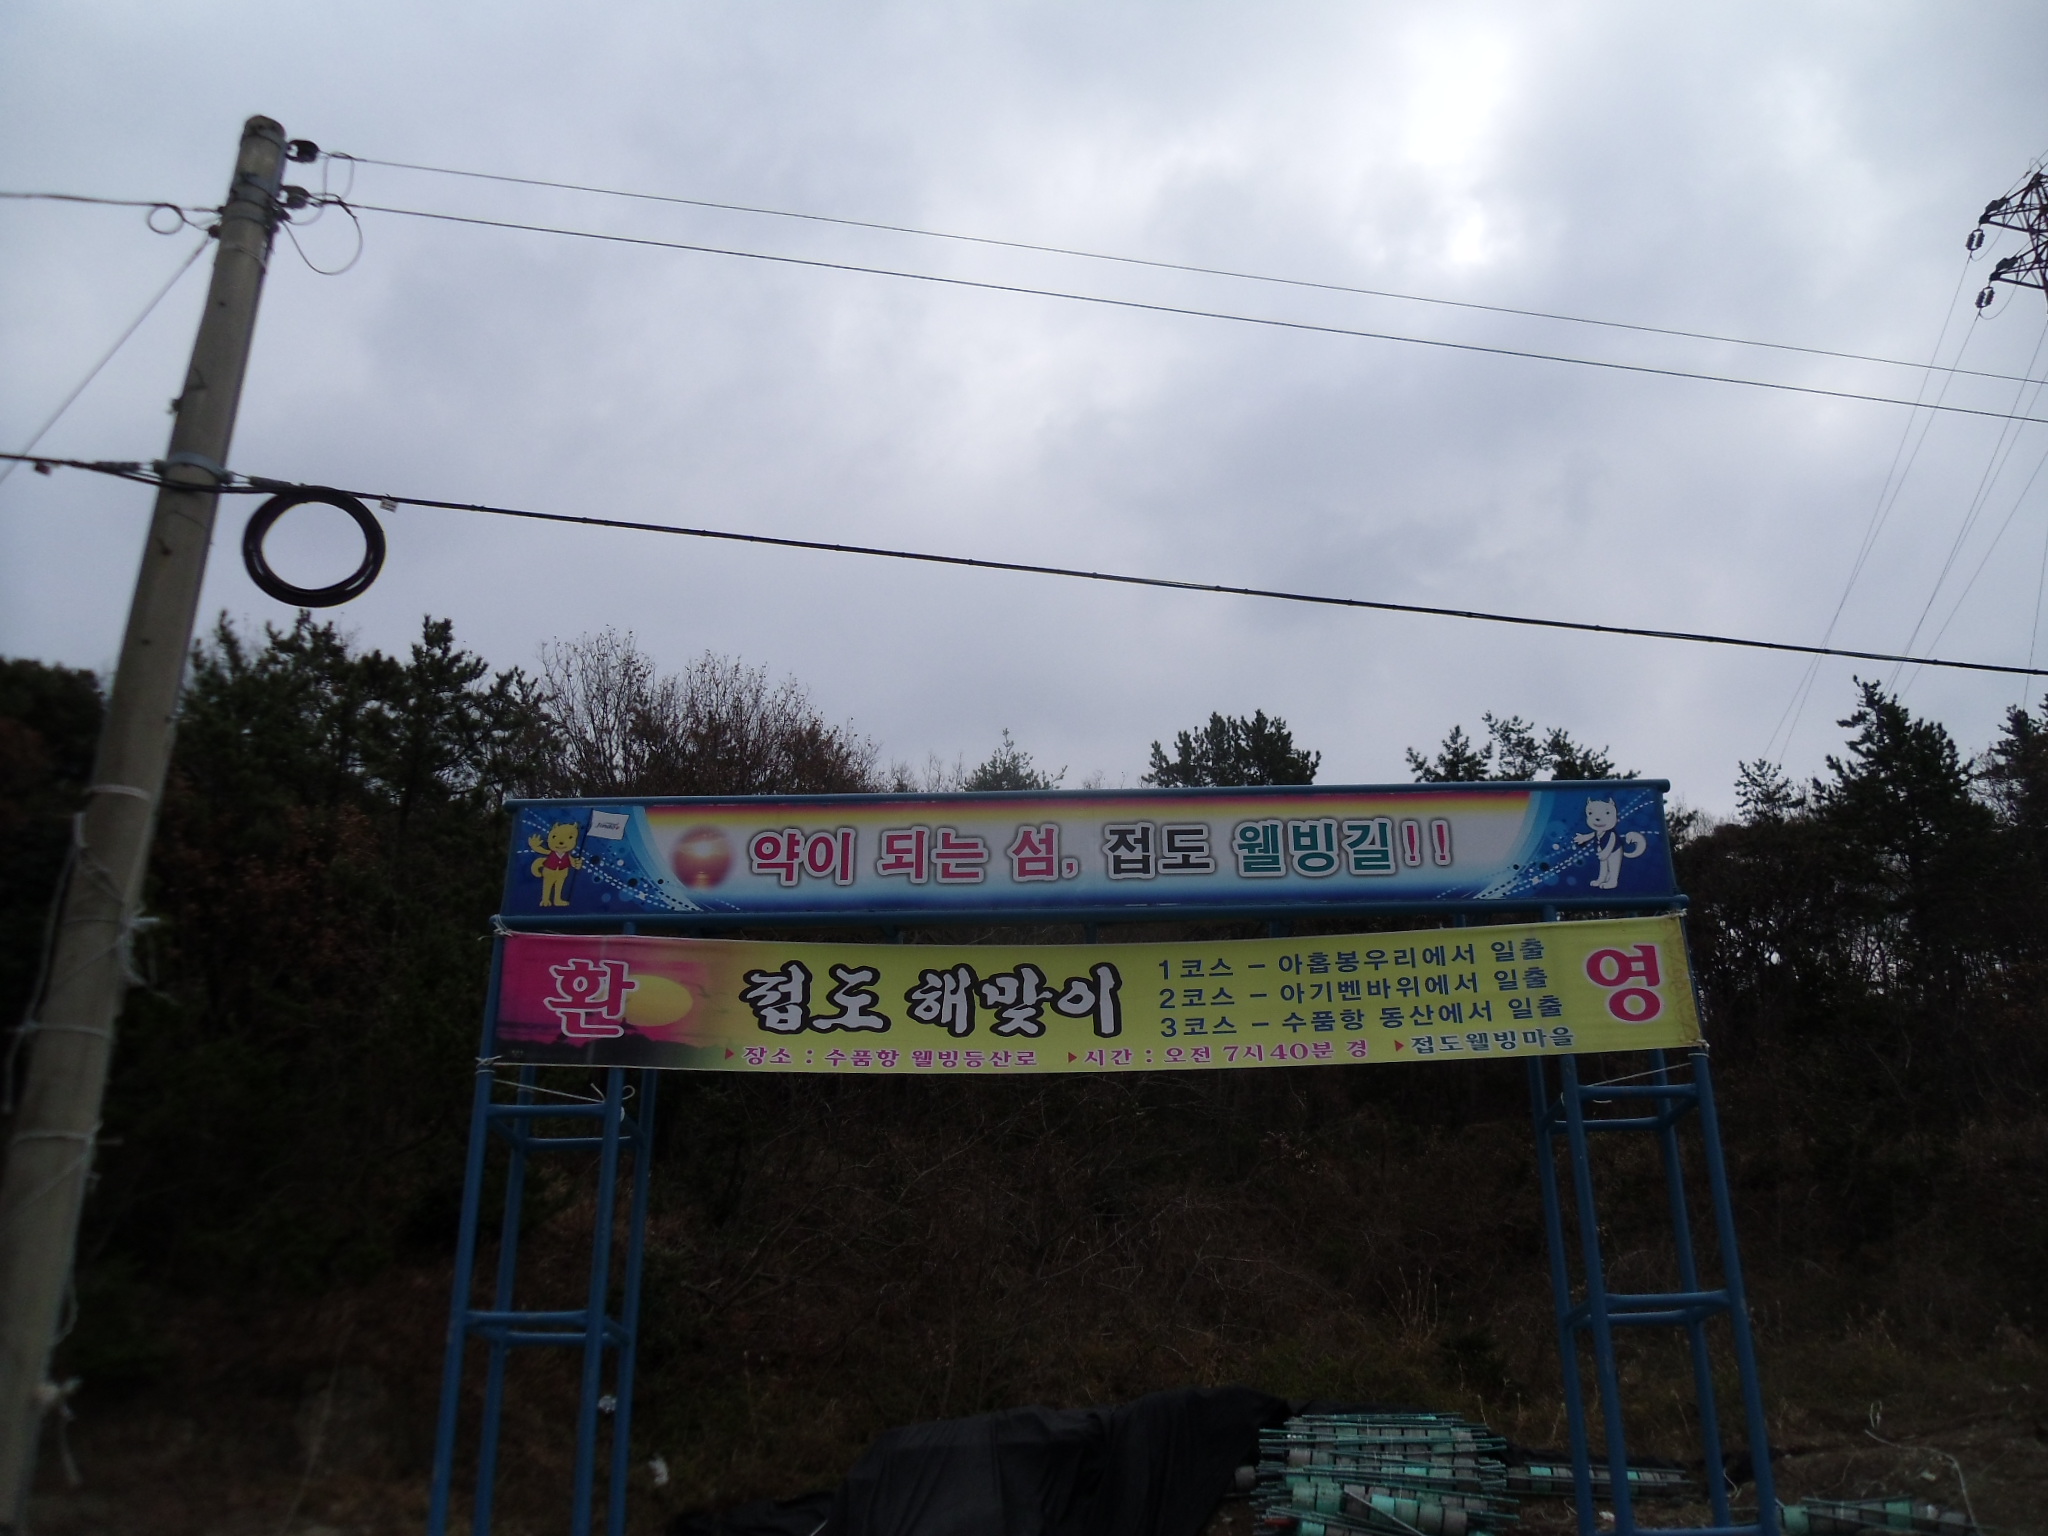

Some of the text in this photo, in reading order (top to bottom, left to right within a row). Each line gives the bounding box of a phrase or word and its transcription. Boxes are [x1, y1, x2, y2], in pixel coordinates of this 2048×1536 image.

[750, 819, 1452, 886] 약이 되는 섬, 접도 웰빙길!!
[1158, 958, 1234, 980] 1코스
[1278, 942, 1476, 976] 아홉봉우리에서
[1490, 937, 1545, 963] 일출
[544, 958, 640, 1038] 환
[739, 960, 1122, 1038] 접도 해맞이
[1159, 987, 1235, 1009] 2코스
[1280, 971, 1479, 1004] 아기벤바위에서
[1493, 966, 1548, 992] 일출
[1585, 944, 1662, 1023] 영
[1160, 1016, 1237, 1038] 3코스
[1281, 1008, 1365, 1033] 수품항
[1379, 1000, 1493, 1029] 동산에서
[1508, 994, 1563, 1020] 일출
[743, 1046, 793, 1067] 장소
[824, 1048, 900, 1068] 수품항
[911, 1049, 1038, 1068] 웰빙등산로
[1084, 1048, 1133, 1066] 시간
[1164, 1047, 1211, 1064] 오전
[1346, 1039, 1368, 1058] 경
[1411, 1026, 1575, 1055] 접도웰빙마을
